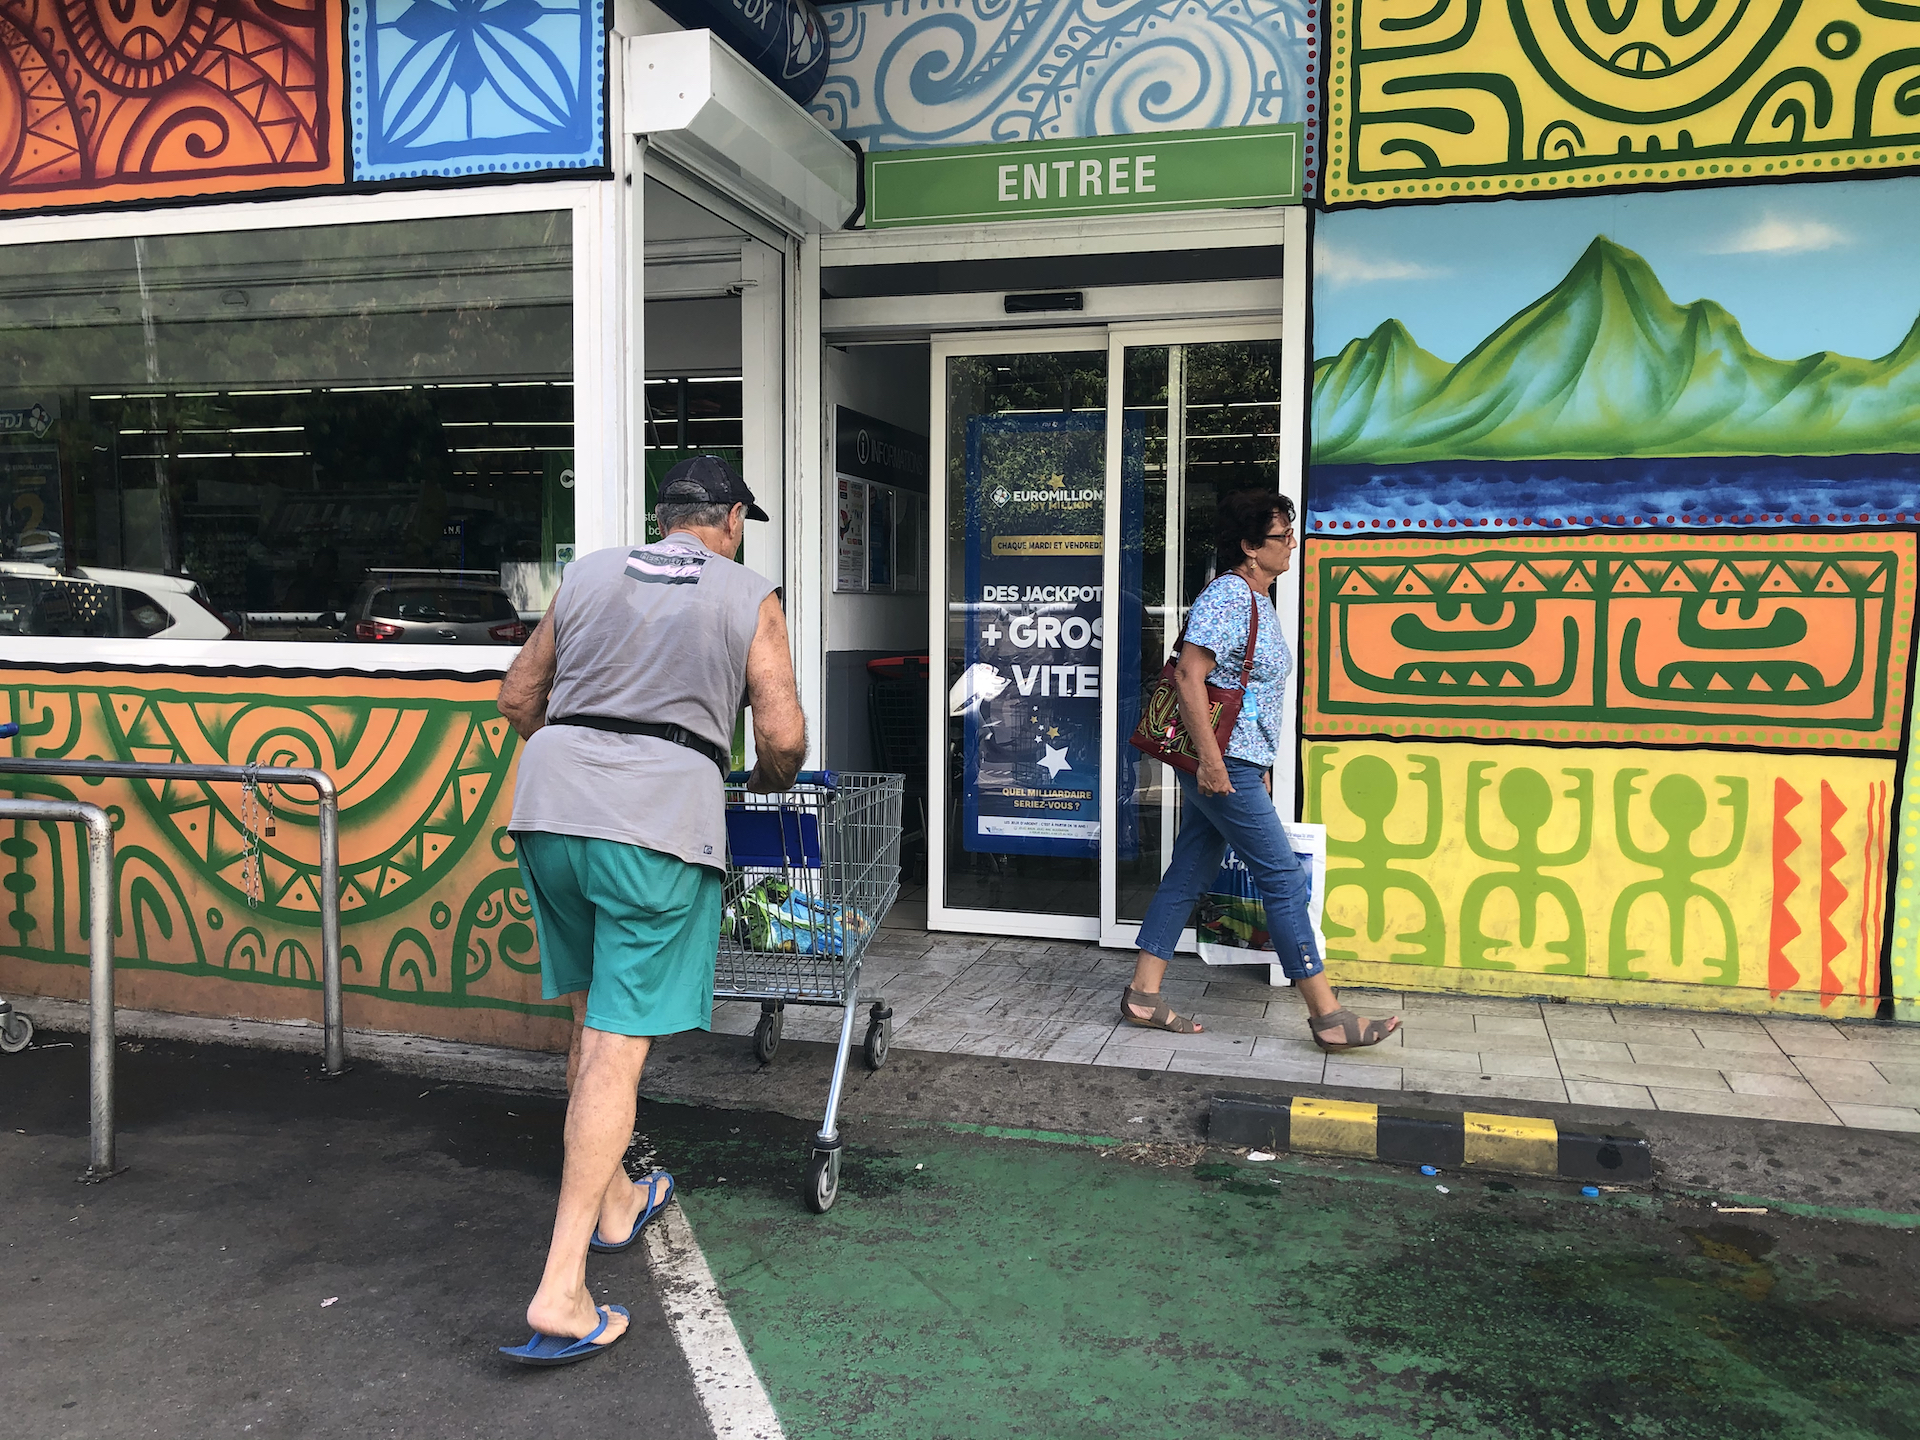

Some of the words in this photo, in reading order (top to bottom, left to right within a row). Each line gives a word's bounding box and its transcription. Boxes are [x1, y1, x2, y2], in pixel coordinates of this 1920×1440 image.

[998, 155, 1157, 201] ENTREE
[871, 439, 924, 475] INFORMATIONS
[1049, 501, 1093, 510] MILLION
[997, 541, 1027, 551] CHAQUE
[1029, 541, 1052, 550] MARDI
[1053, 541, 1063, 550] ET
[1065, 541, 1102, 550] VENDREDI
[983, 585, 1019, 602] DES
[1011, 664, 1099, 698] VITE
[1002, 788, 1026, 797] QUEL
[1027, 788, 1092, 800] MILLIARDAIRE
[1013, 799, 1074, 810] SERIEZ-VOUS
